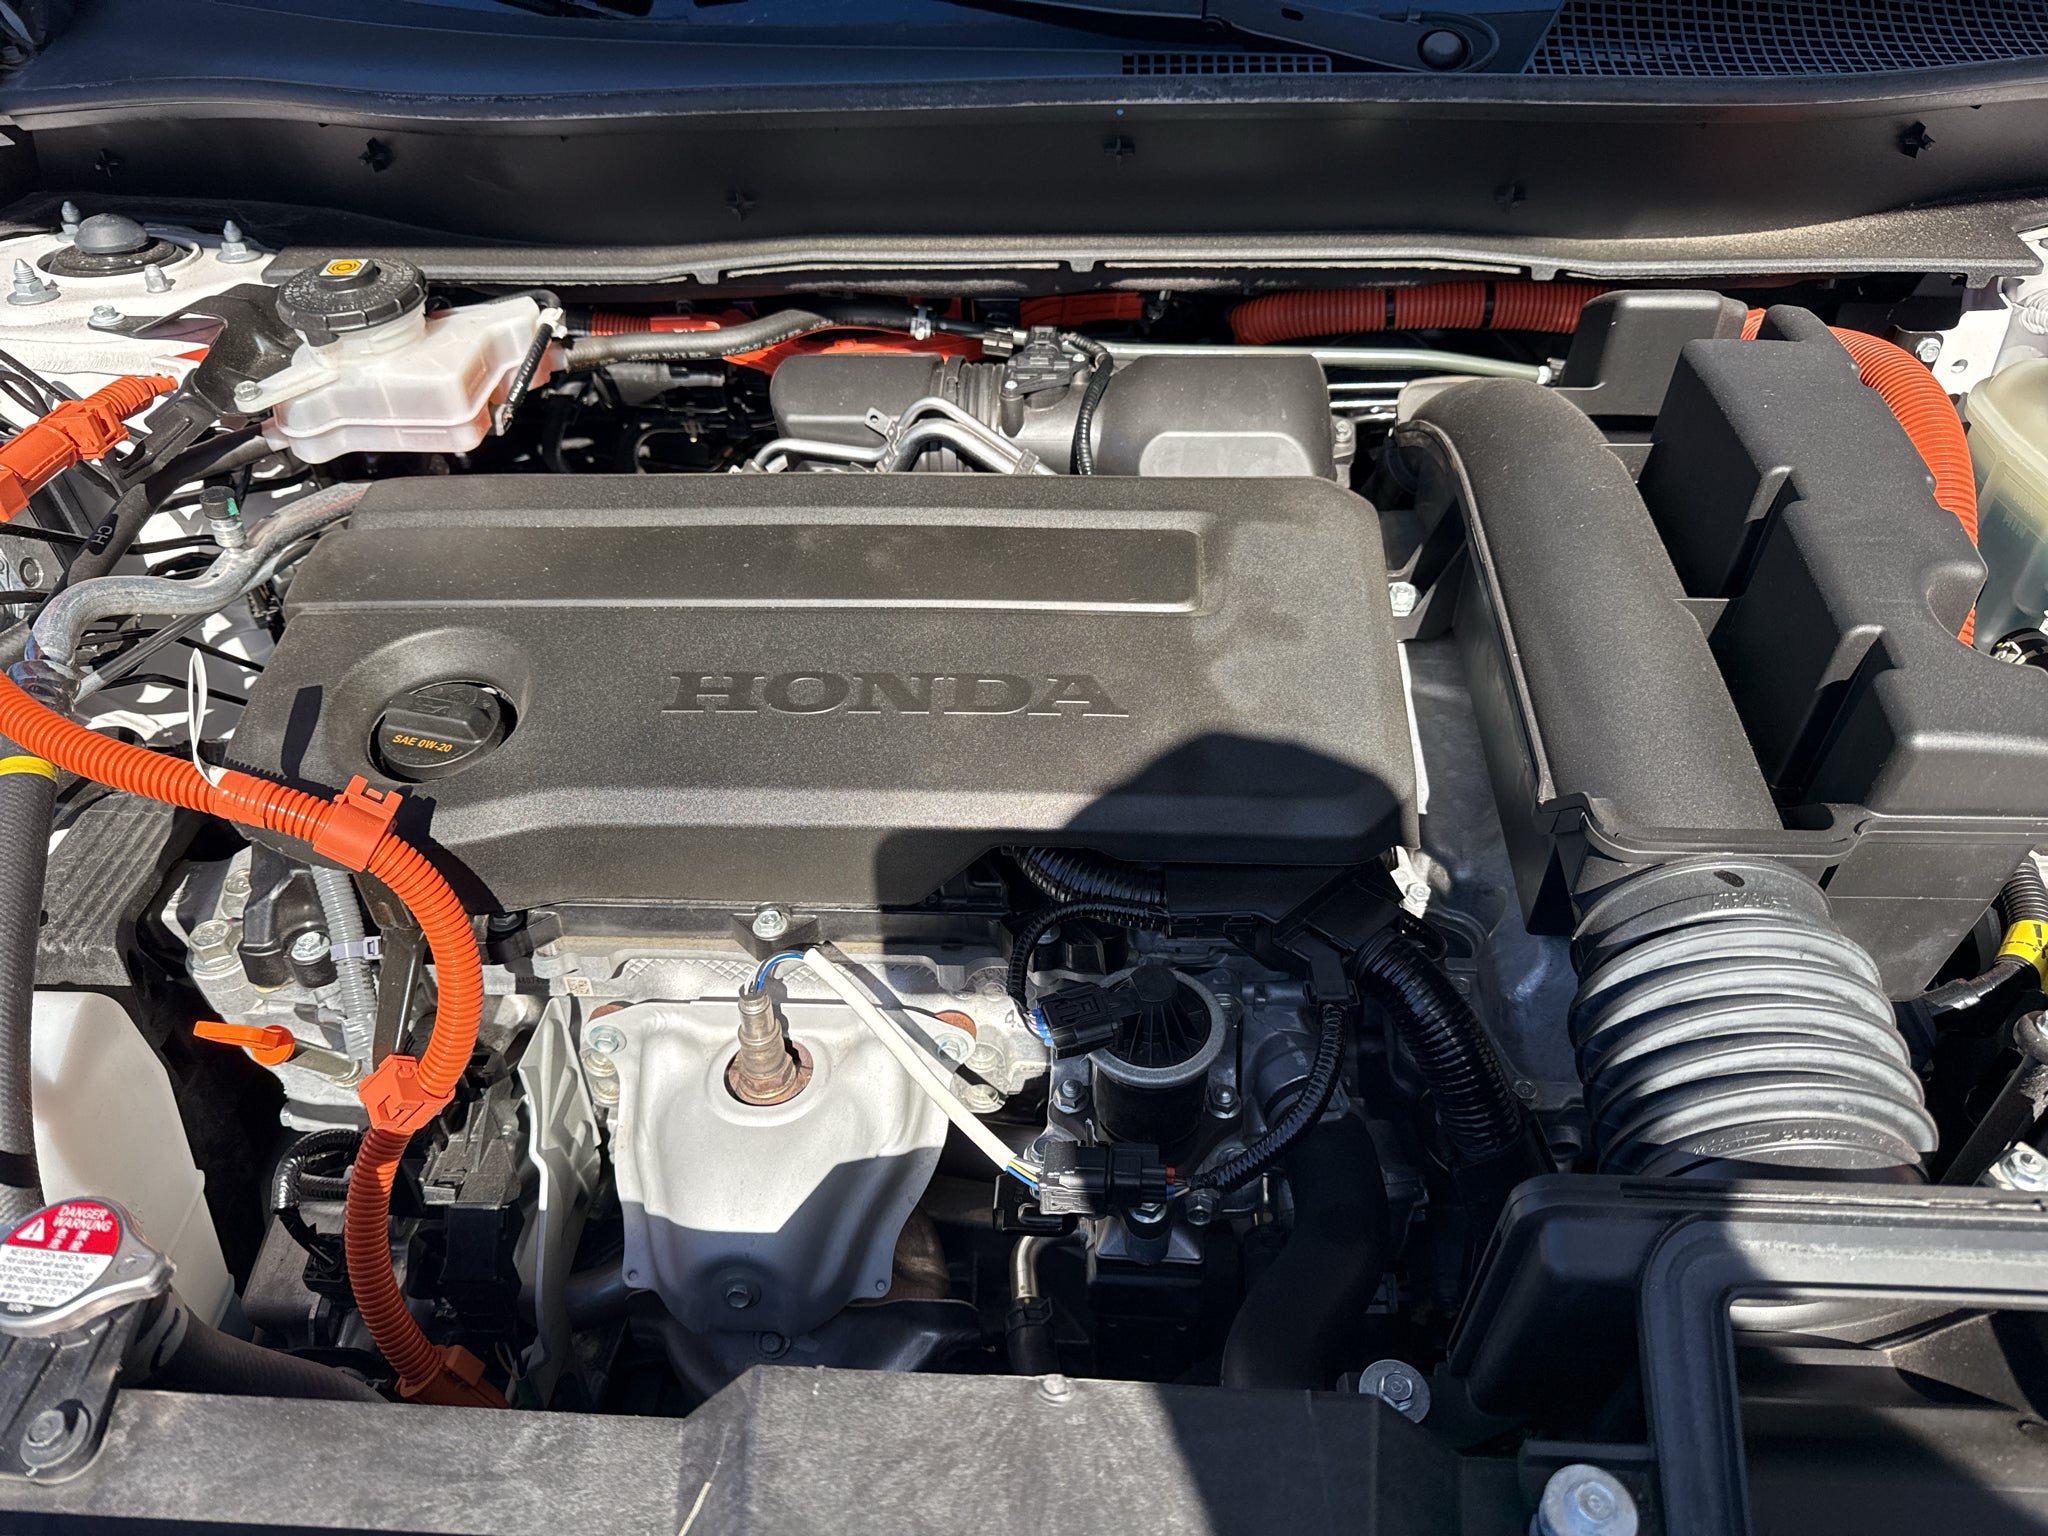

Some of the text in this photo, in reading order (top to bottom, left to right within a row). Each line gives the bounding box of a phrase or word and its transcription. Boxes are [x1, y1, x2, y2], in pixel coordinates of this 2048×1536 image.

[661, 671, 1129, 717] HONDA
[392, 734, 453, 753] SAE 0W-20
[58, 1204, 108, 1220] DANGER
[52, 1215, 113, 1232] WARNUNG
